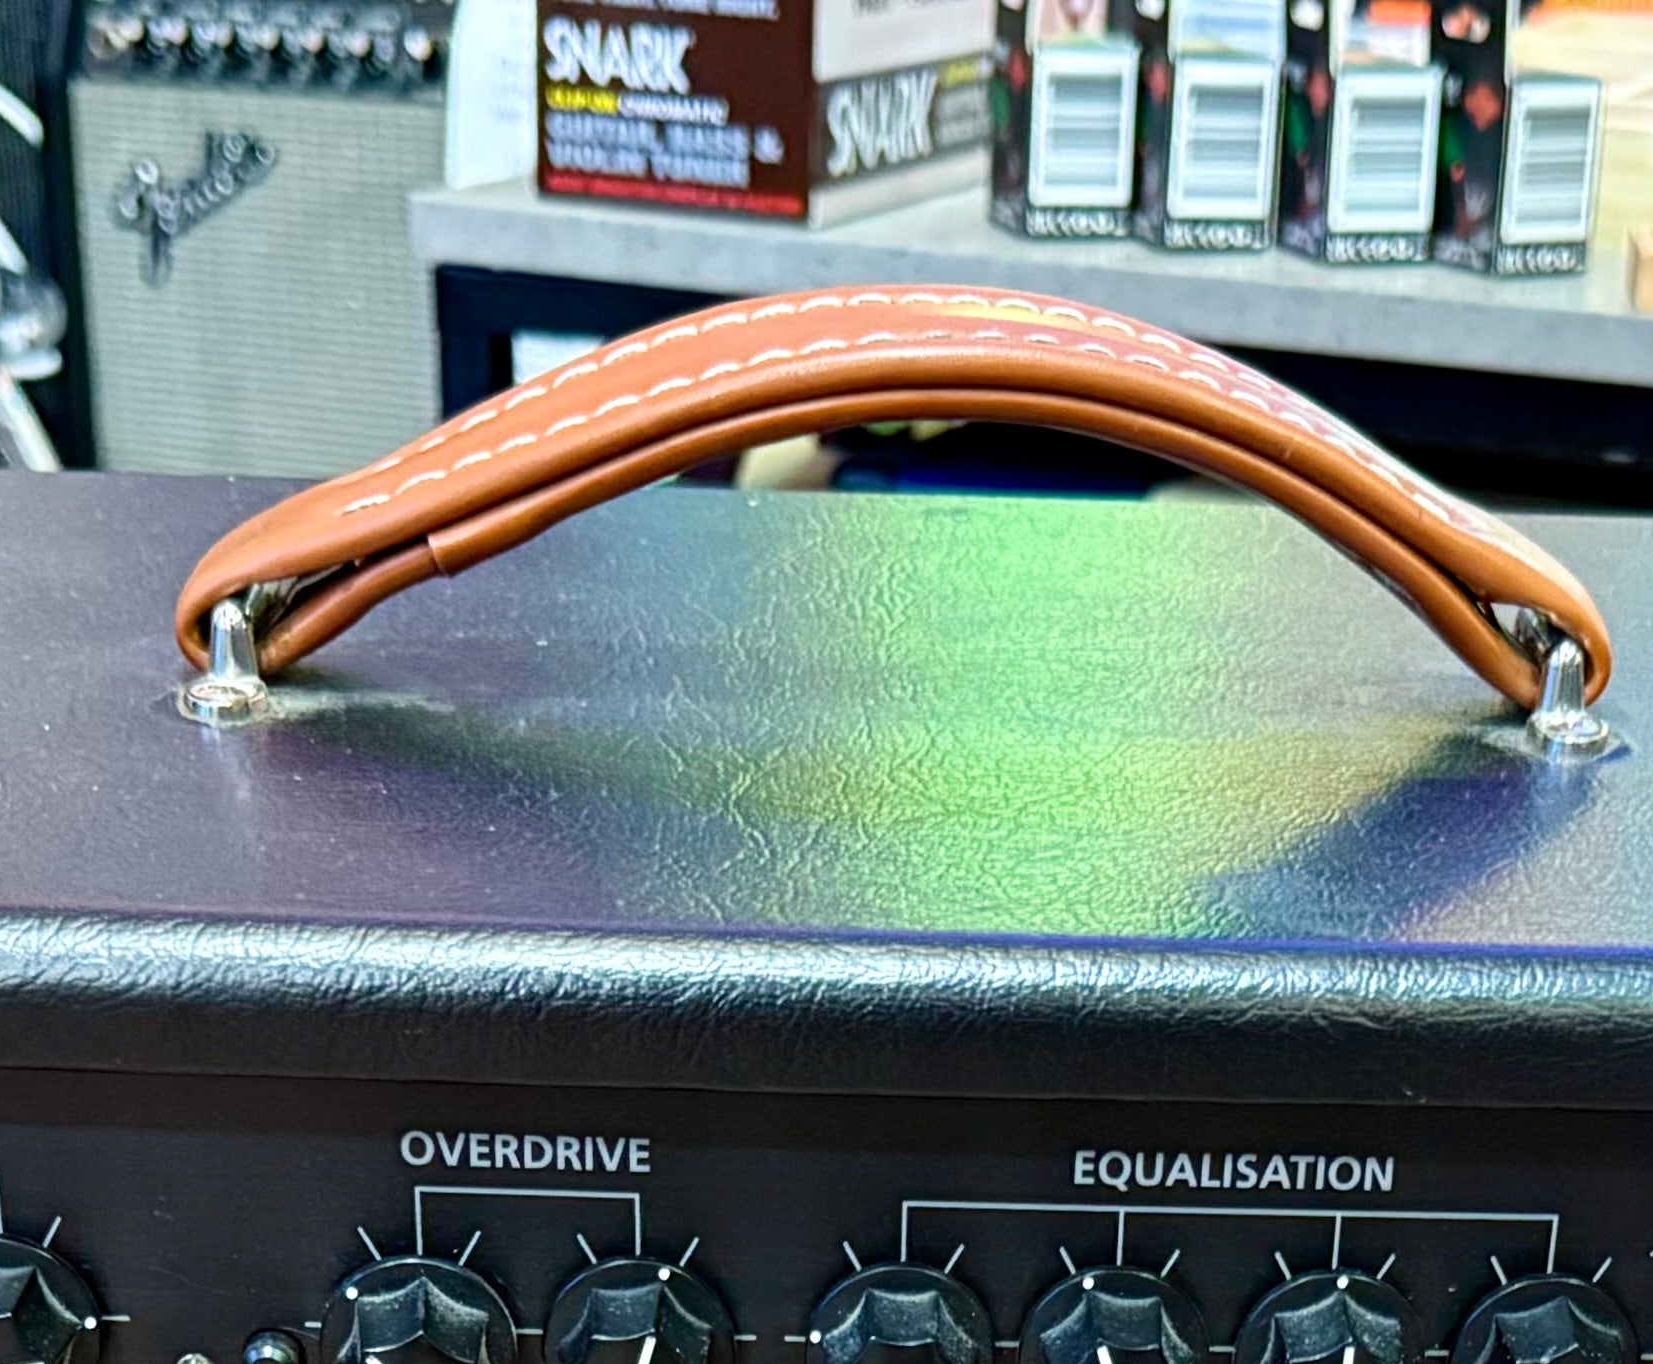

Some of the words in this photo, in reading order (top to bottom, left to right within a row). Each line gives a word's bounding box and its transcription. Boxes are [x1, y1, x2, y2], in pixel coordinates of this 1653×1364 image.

[544, 15, 695, 94] SNARK
[827, 67, 937, 178] SNARK
[400, 1131, 651, 1173] OVERDRIVE
[1073, 1150, 1394, 1192] EQUALISATION
